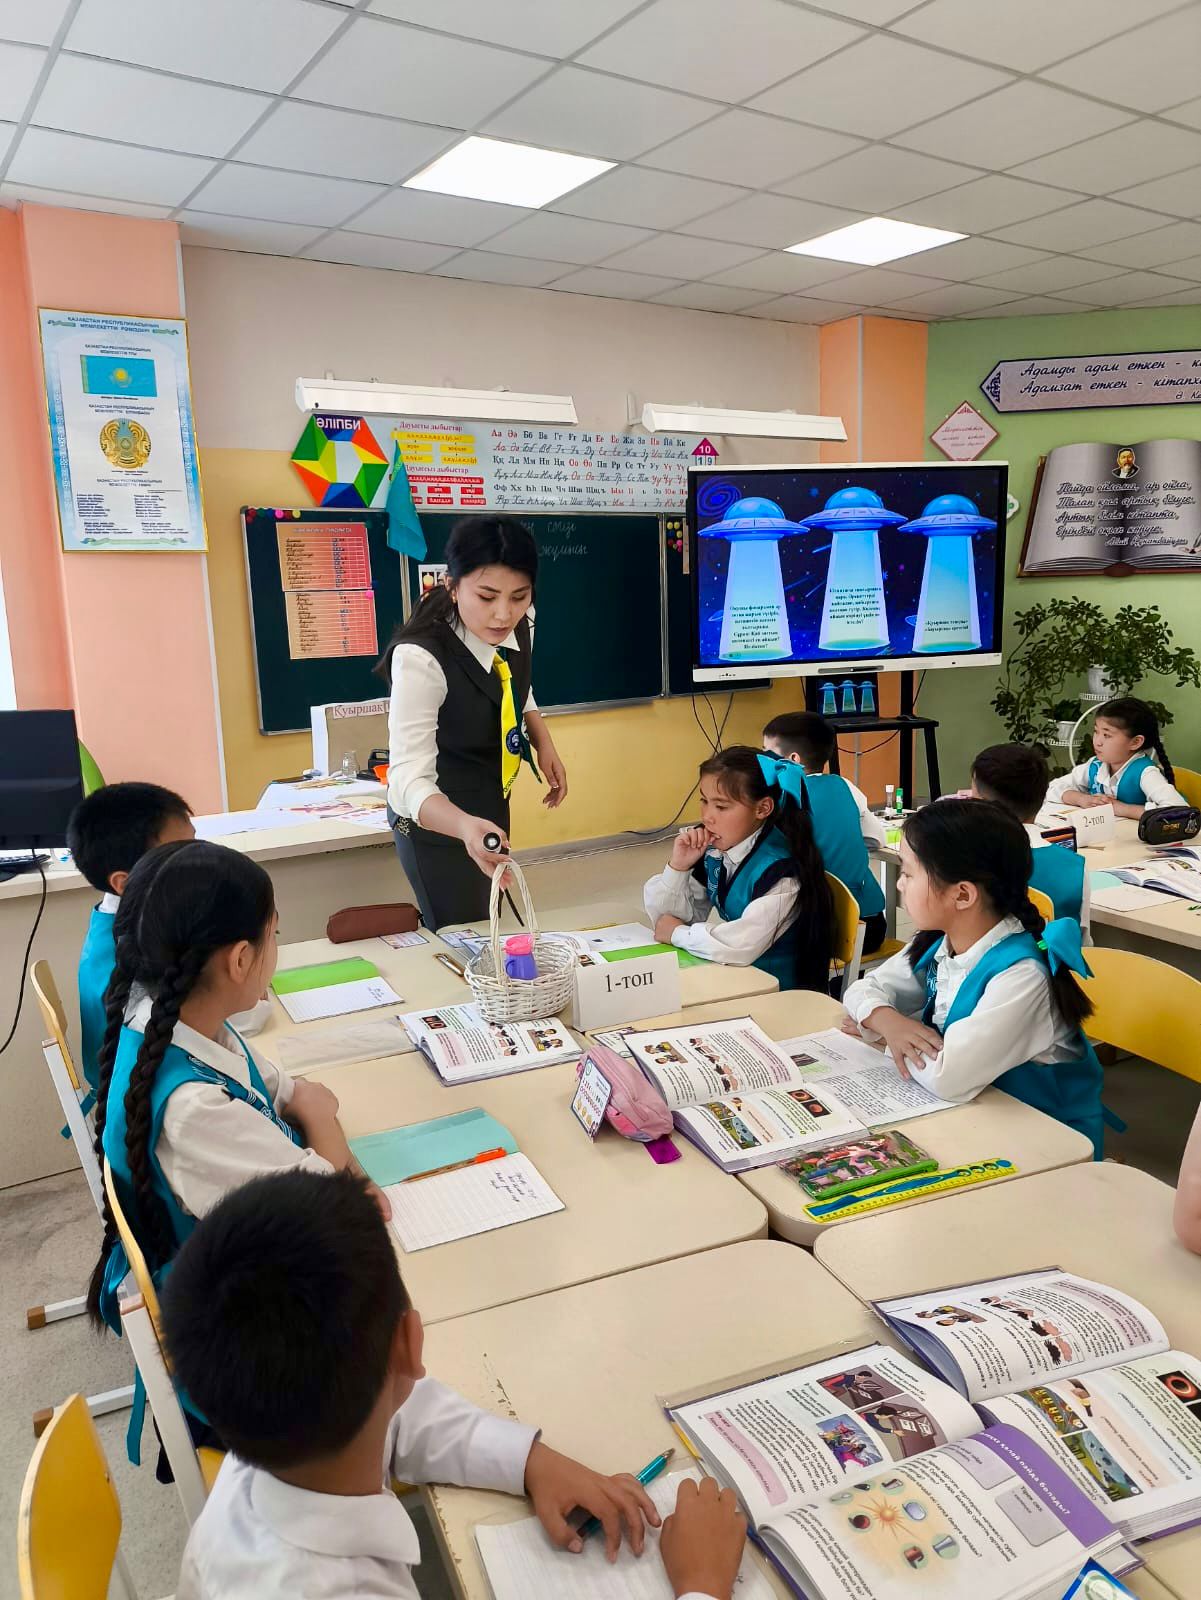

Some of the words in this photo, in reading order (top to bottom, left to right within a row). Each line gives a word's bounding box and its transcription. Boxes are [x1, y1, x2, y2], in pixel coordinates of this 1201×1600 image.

[1020, 362, 1075, 380] Адамды
[1084, 363, 1119, 376] адам
[1128, 360, 1166, 371] еткен
[1020, 378, 1082, 397] Адамзат
[1090, 380, 1128, 390] еткен
[316, 417, 361, 430] ӘЛІПБИ
[700, 446, 711, 454] 10
[707, 456, 713, 466] 9
[1084, 815, 1105, 828] 2-топ
[604, 972, 654, 992] 1-топ
[1040, 1482, 1070, 1515] болады?
